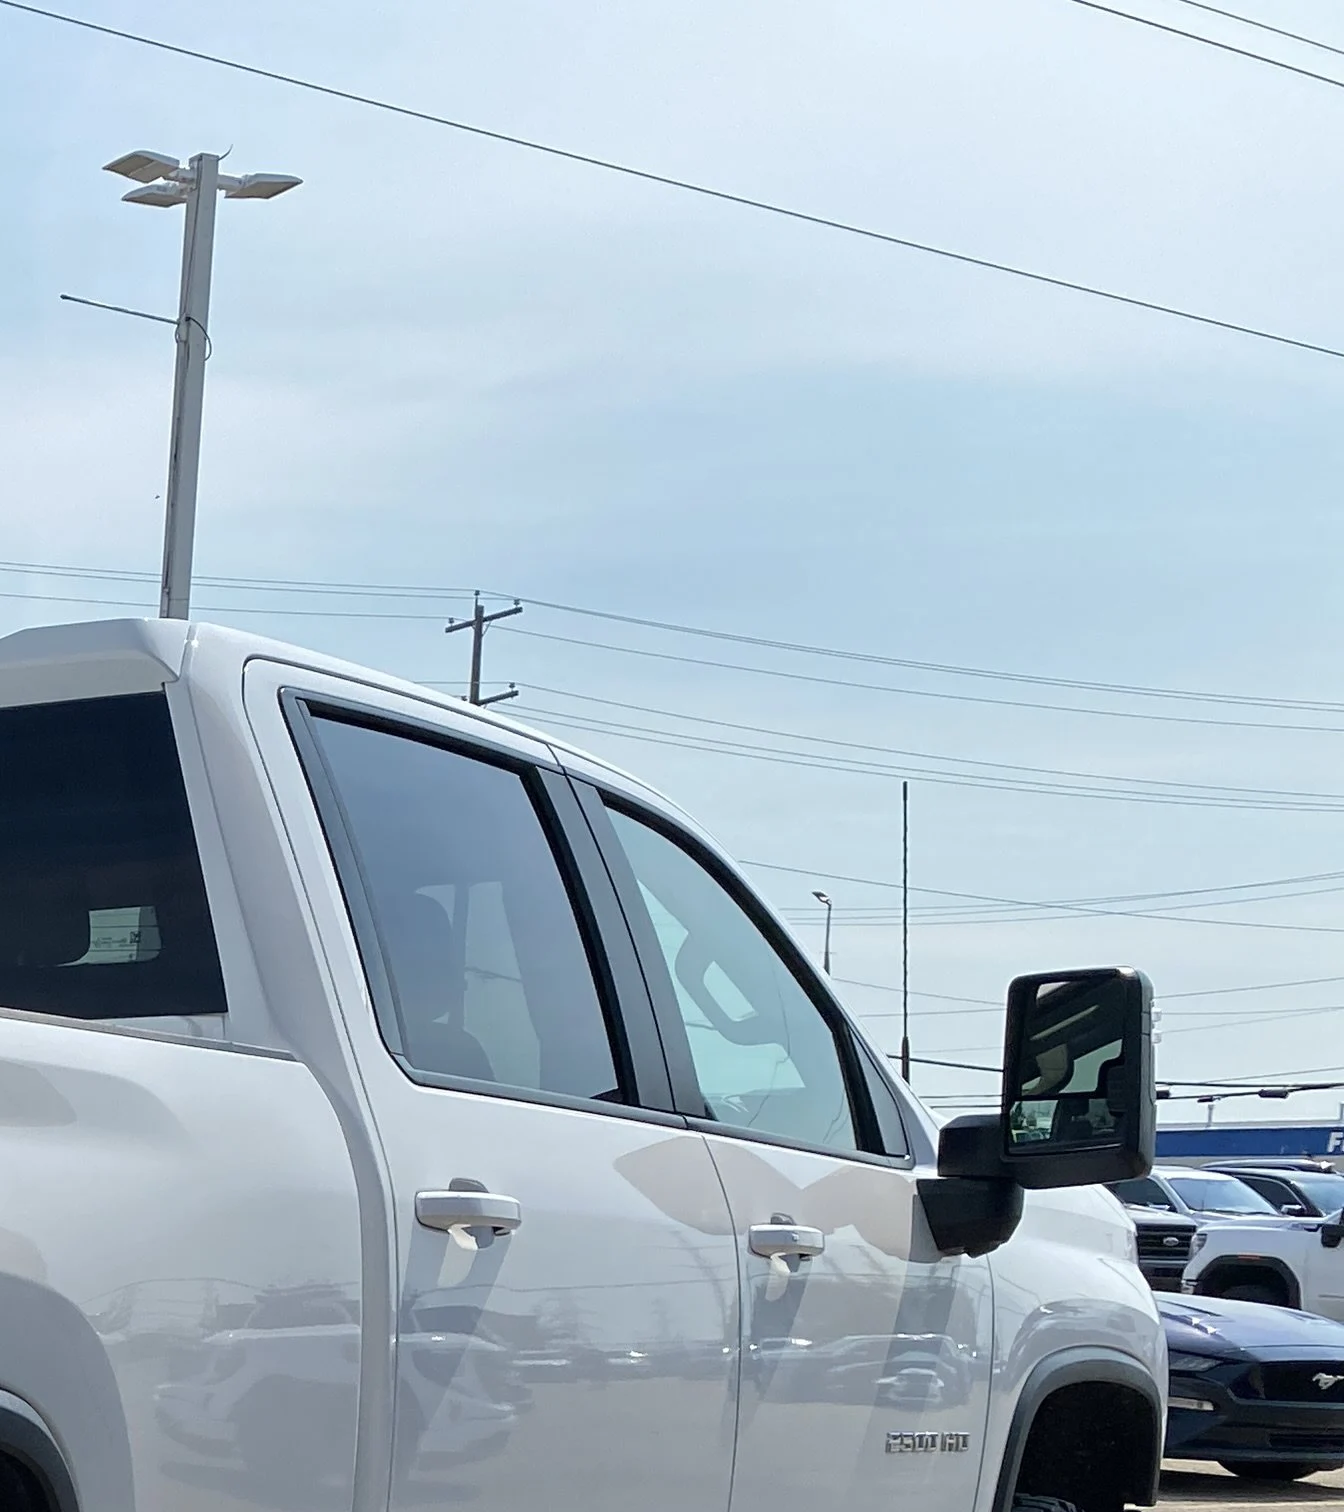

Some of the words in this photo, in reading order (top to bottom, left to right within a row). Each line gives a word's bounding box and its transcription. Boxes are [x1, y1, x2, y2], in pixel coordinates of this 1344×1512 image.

[1327, 1131, 1344, 1153] F
[885, 1431, 938, 1453] 2500
[940, 1431, 970, 1452] HD
